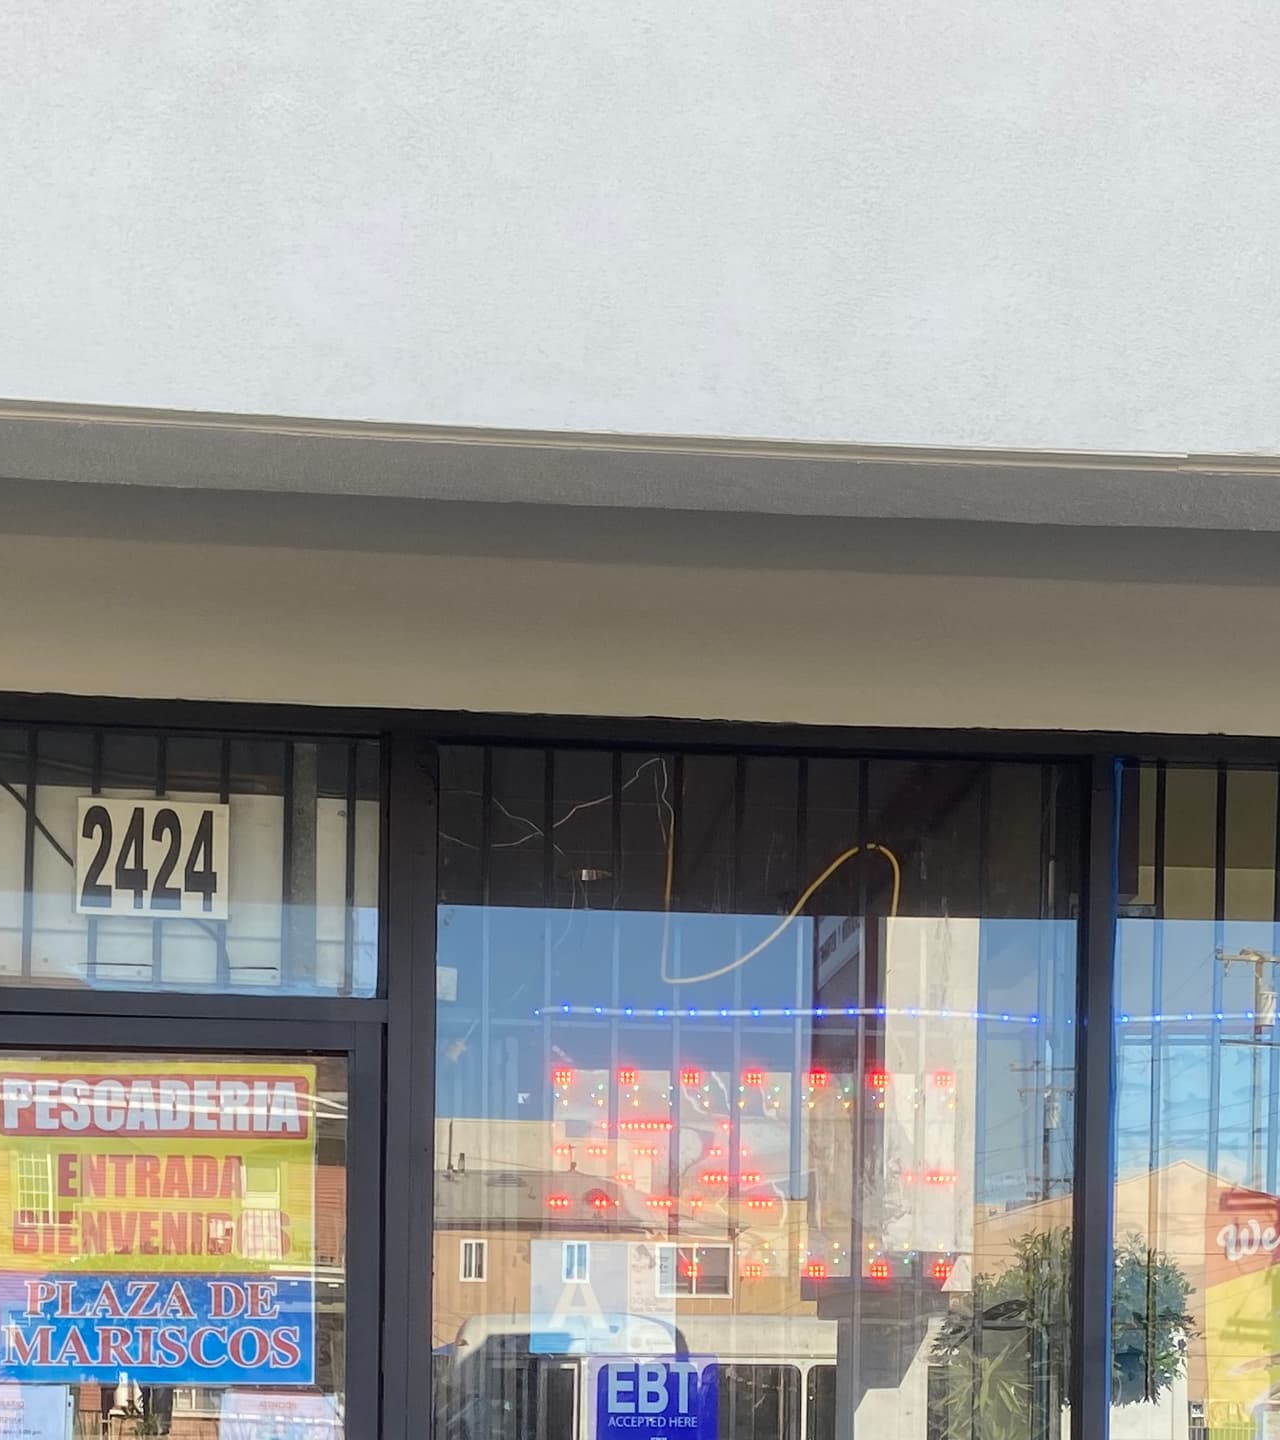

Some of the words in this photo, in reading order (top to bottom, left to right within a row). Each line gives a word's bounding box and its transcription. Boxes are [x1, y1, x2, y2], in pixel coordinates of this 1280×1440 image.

[80, 805, 218, 912] 2424
[3, 1077, 302, 1133] PESCADERIA
[57, 1153, 244, 1199] ENTRADA
[24, 1281, 194, 1318] PLAZA
[209, 1281, 279, 1319] DE
[1, 1325, 302, 1368] MARISCOS
[607, 1363, 698, 1413] EBT
[607, 1415, 666, 1428] ACCEPTED
[669, 1416, 698, 1428] HERE
